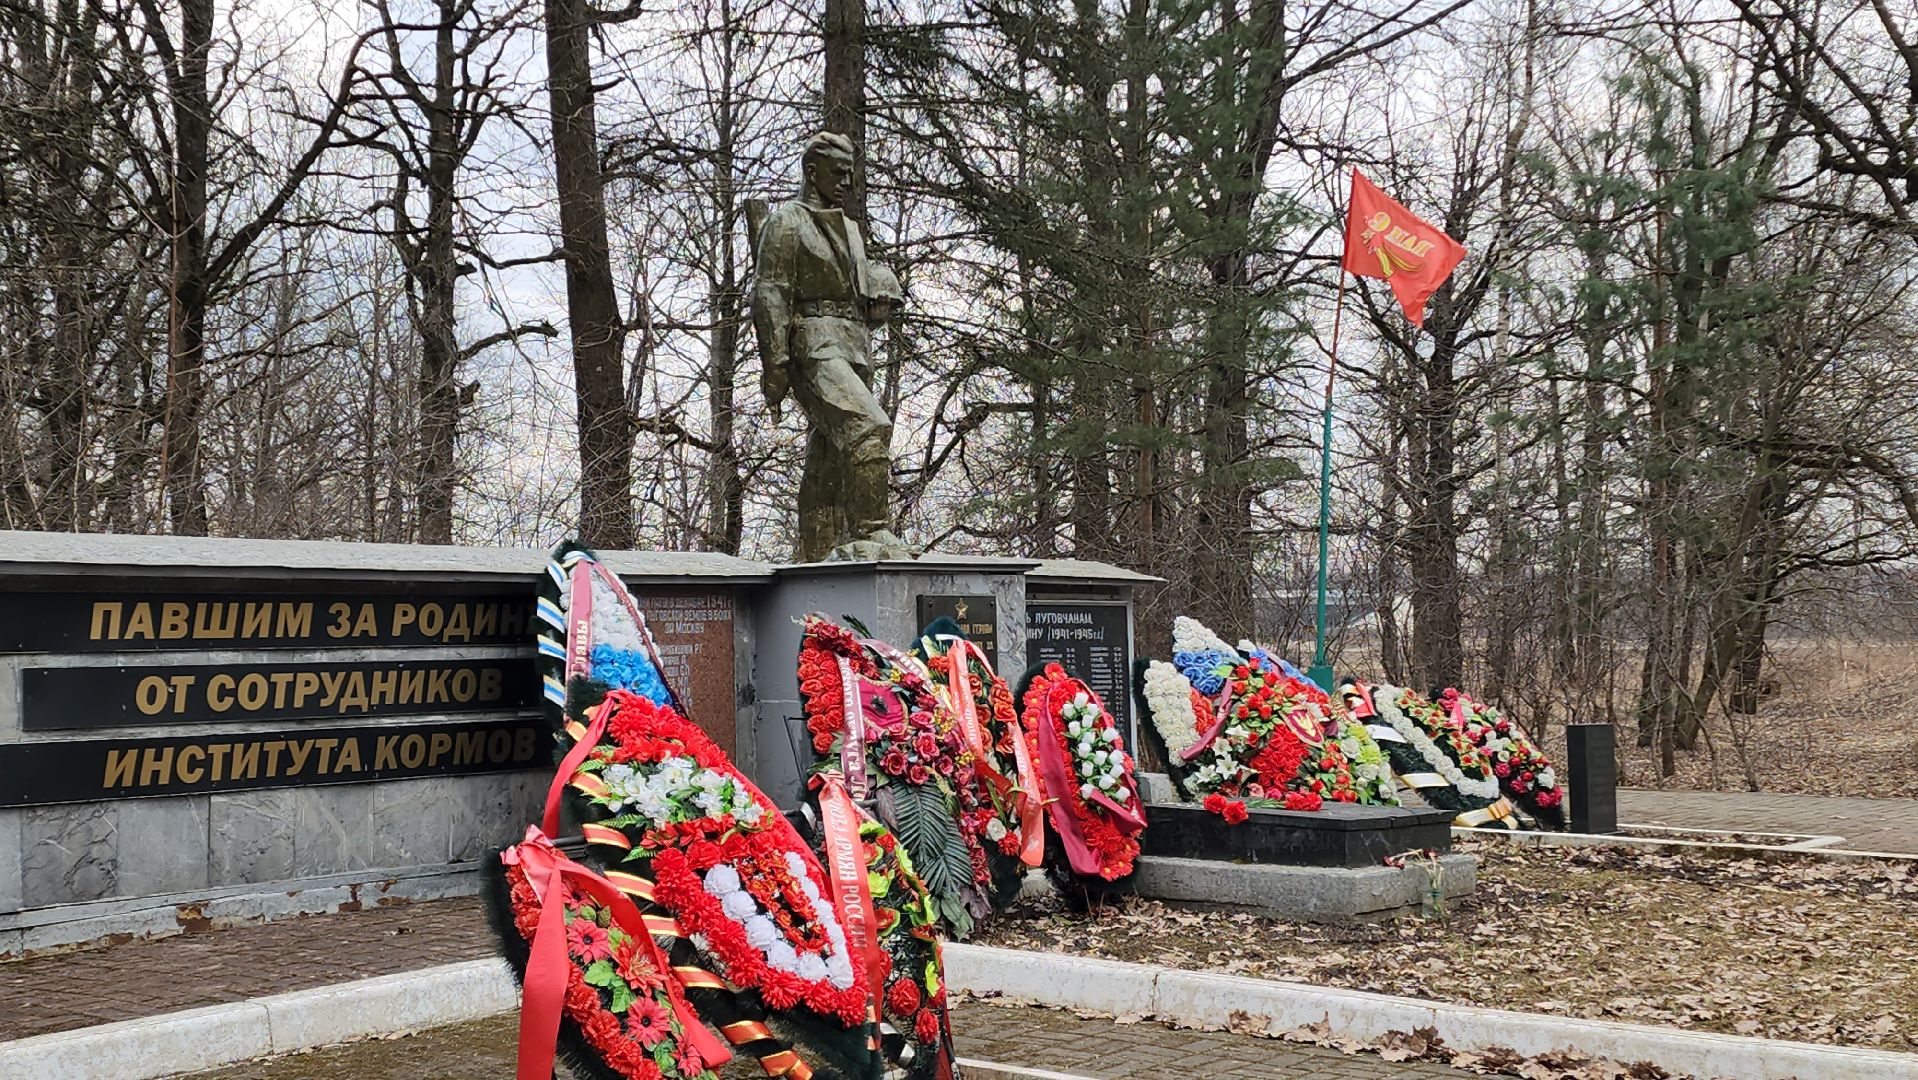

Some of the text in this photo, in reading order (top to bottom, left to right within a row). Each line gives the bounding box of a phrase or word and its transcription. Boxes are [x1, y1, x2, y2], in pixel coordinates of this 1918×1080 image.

[90, 602, 525, 643] ПАВШИМ ЗА РОДИН
[135, 668, 502, 715] ОТ СОТРУДНИКОВ
[102, 727, 537, 789] ИНСТИТУТА КОРМОВ
[834, 834, 859, 881] АРМЯН
